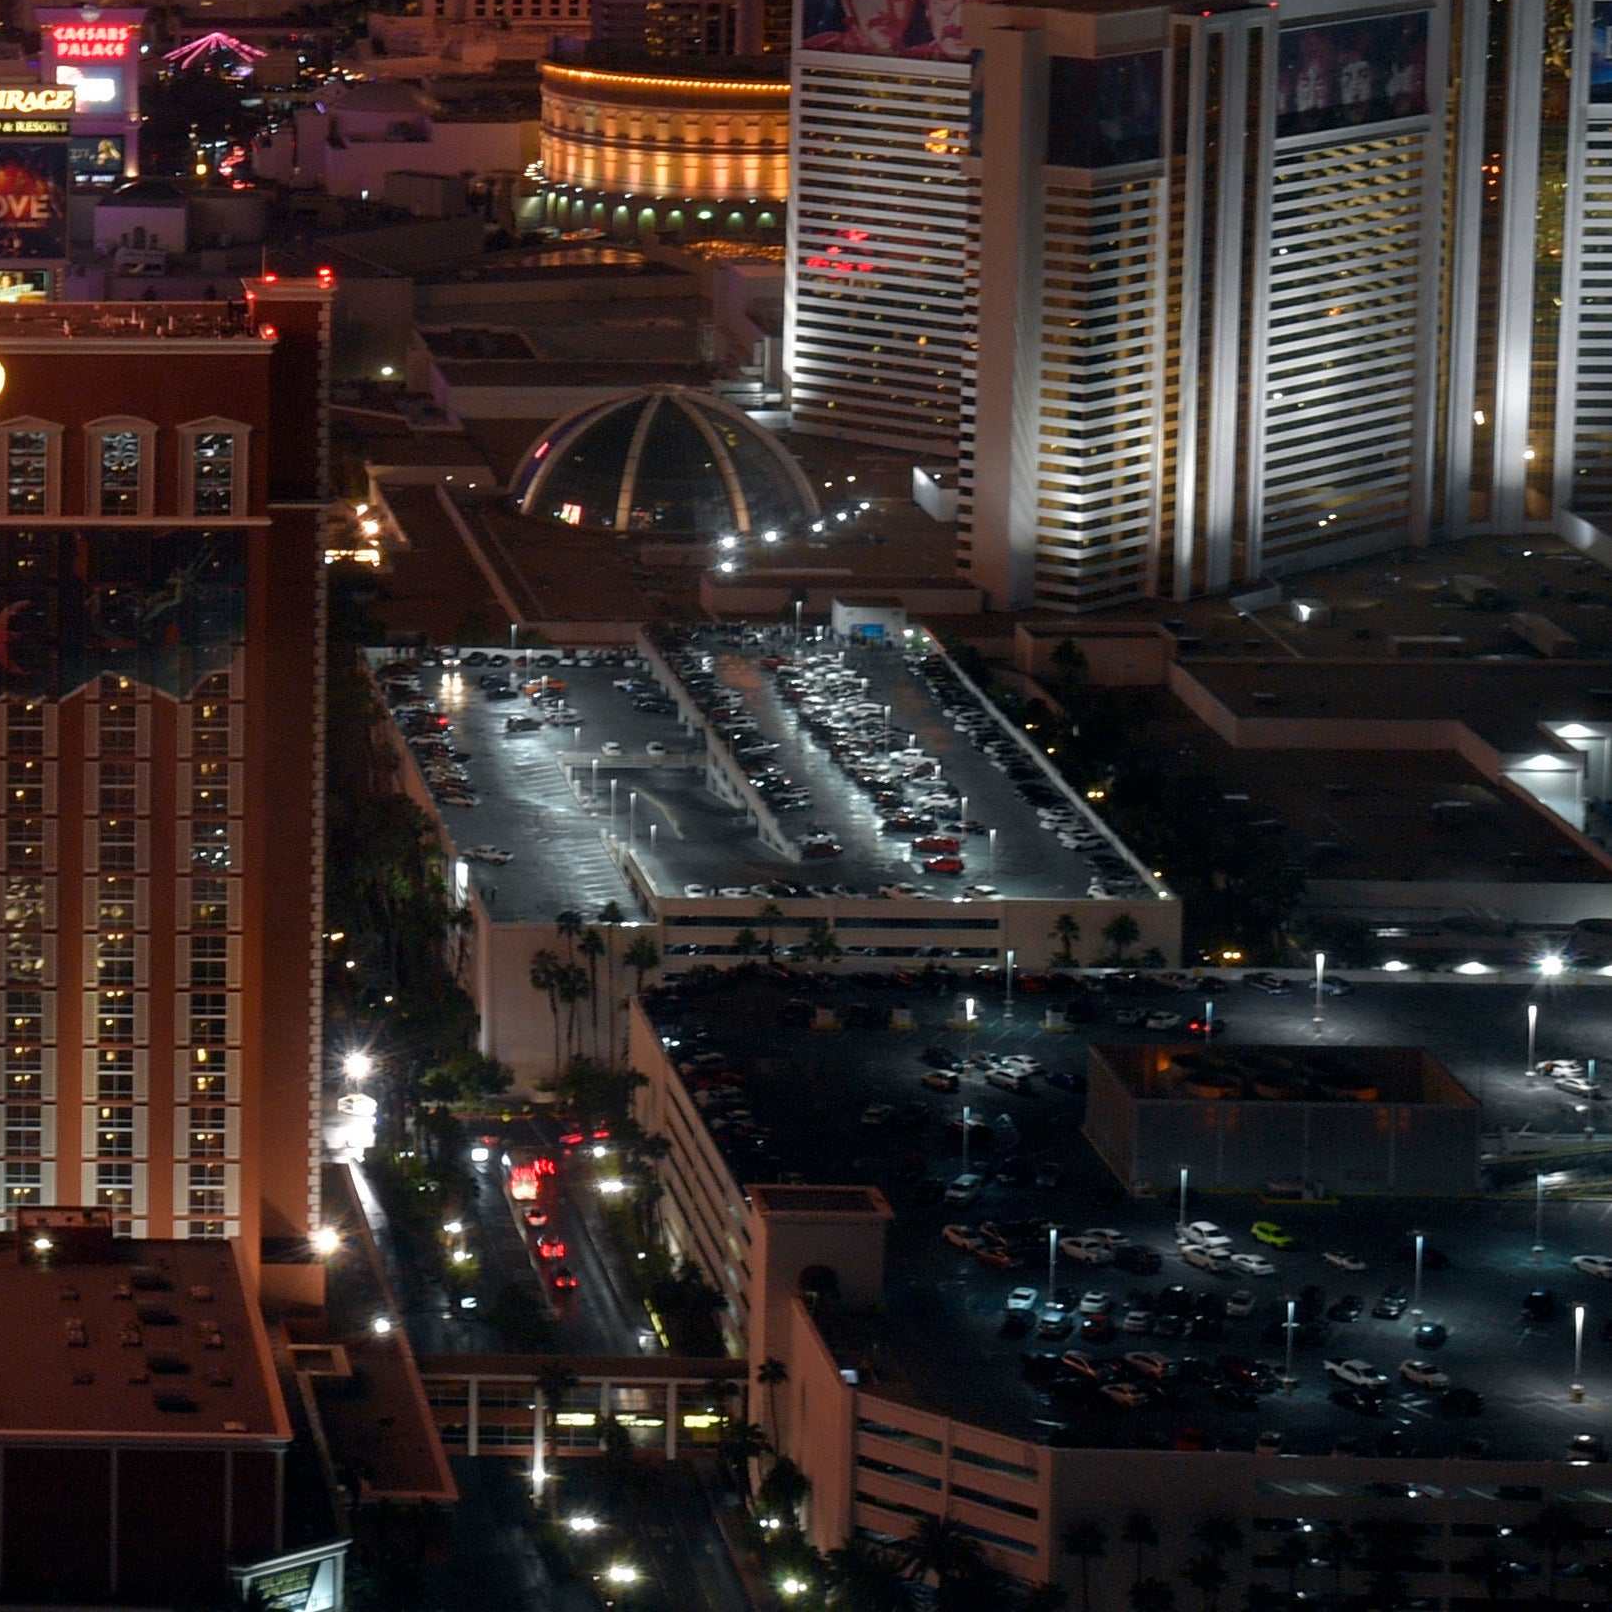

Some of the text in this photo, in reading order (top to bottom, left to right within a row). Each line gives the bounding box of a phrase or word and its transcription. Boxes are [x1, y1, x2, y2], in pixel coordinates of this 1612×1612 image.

[53, 26, 130, 42] CAESARS
[56, 42, 126, 57] PALACE
[2, 122, 14, 133] &
[15, 121, 68, 133] RESORT
